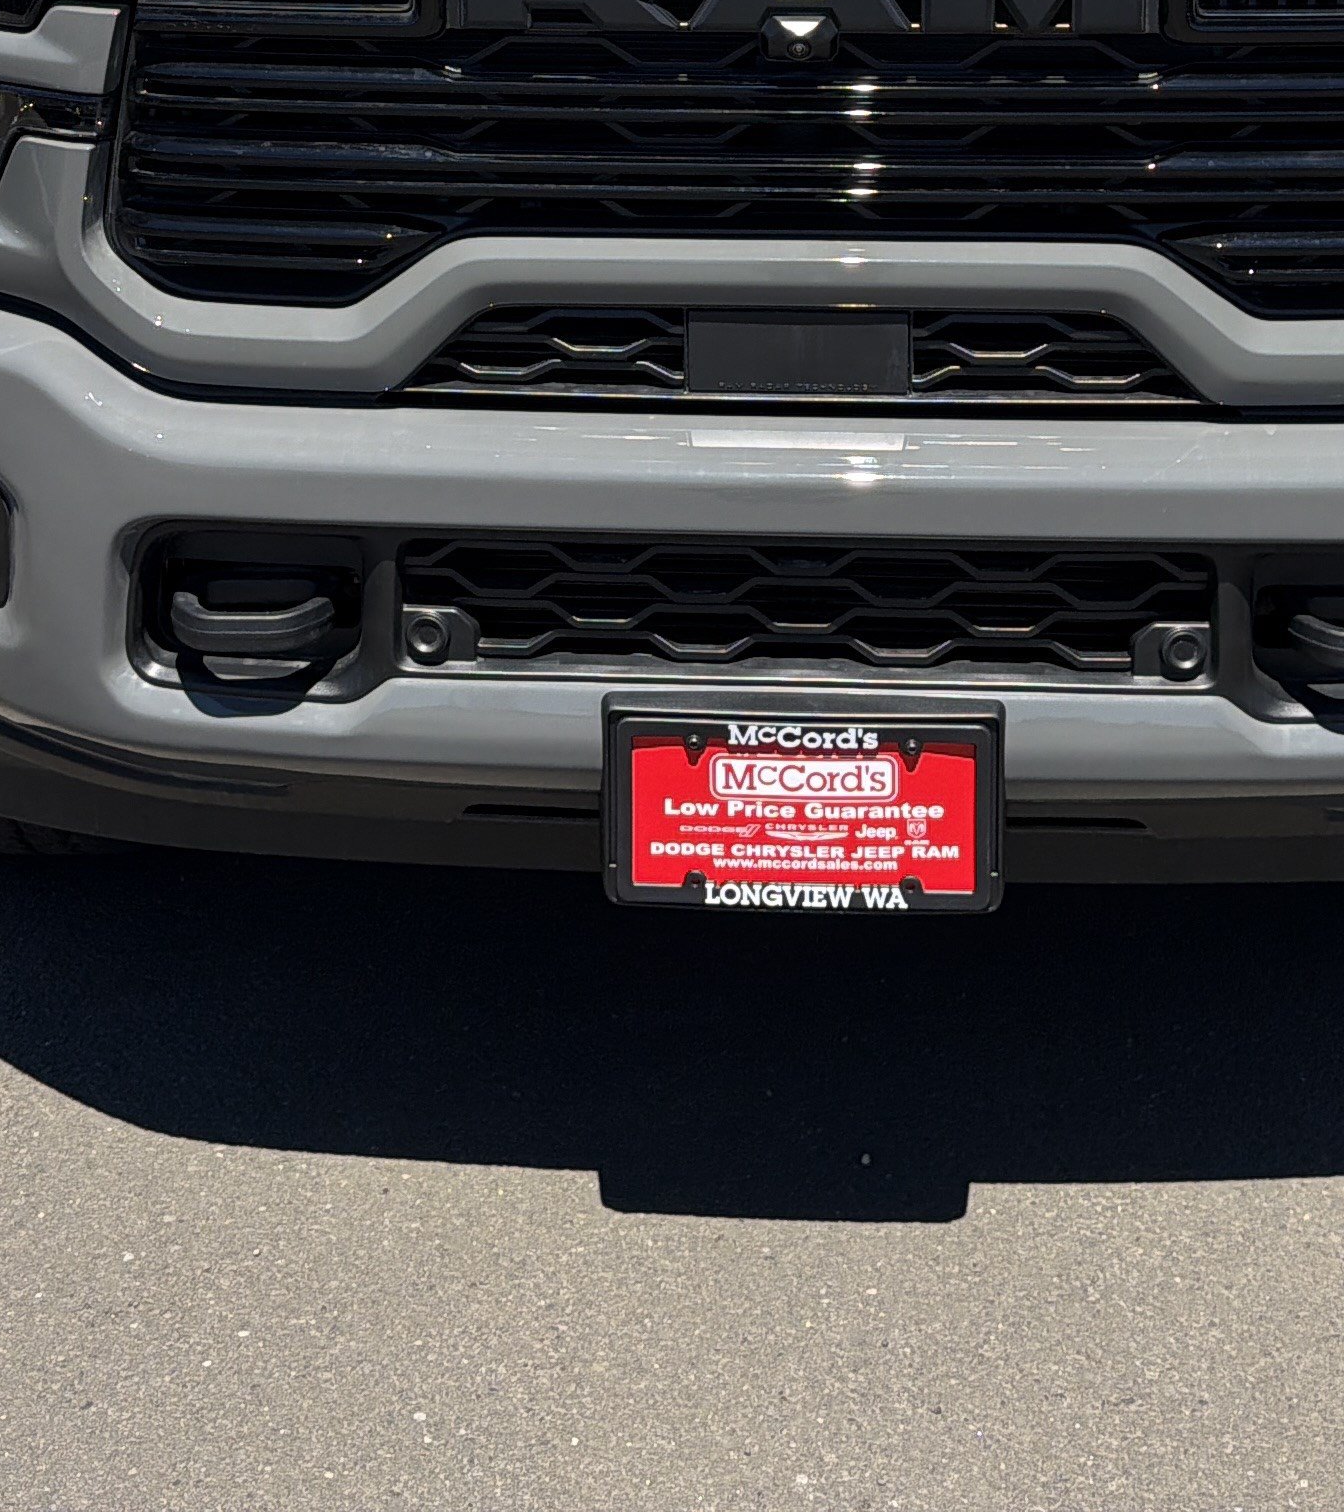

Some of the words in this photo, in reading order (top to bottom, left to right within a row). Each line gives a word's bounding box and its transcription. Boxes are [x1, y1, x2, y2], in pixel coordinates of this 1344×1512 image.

[728, 725, 879, 750] McCord's
[721, 762, 887, 794] McCord's
[664, 798, 719, 816] Low
[727, 800, 796, 818] Price
[804, 802, 945, 819] Guarantee
[765, 823, 849, 831] CHRYSLER
[855, 824, 897, 841] Jeep
[651, 842, 725, 855] DODGE
[731, 844, 845, 857] CHRYSLER
[851, 846, 905, 858] JEEP
[911, 845, 960, 859] RAM
[713, 857, 898, 871] www.mccordsales.com
[705, 883, 856, 908] LONGVIEW
[860, 888, 908, 909] WA
